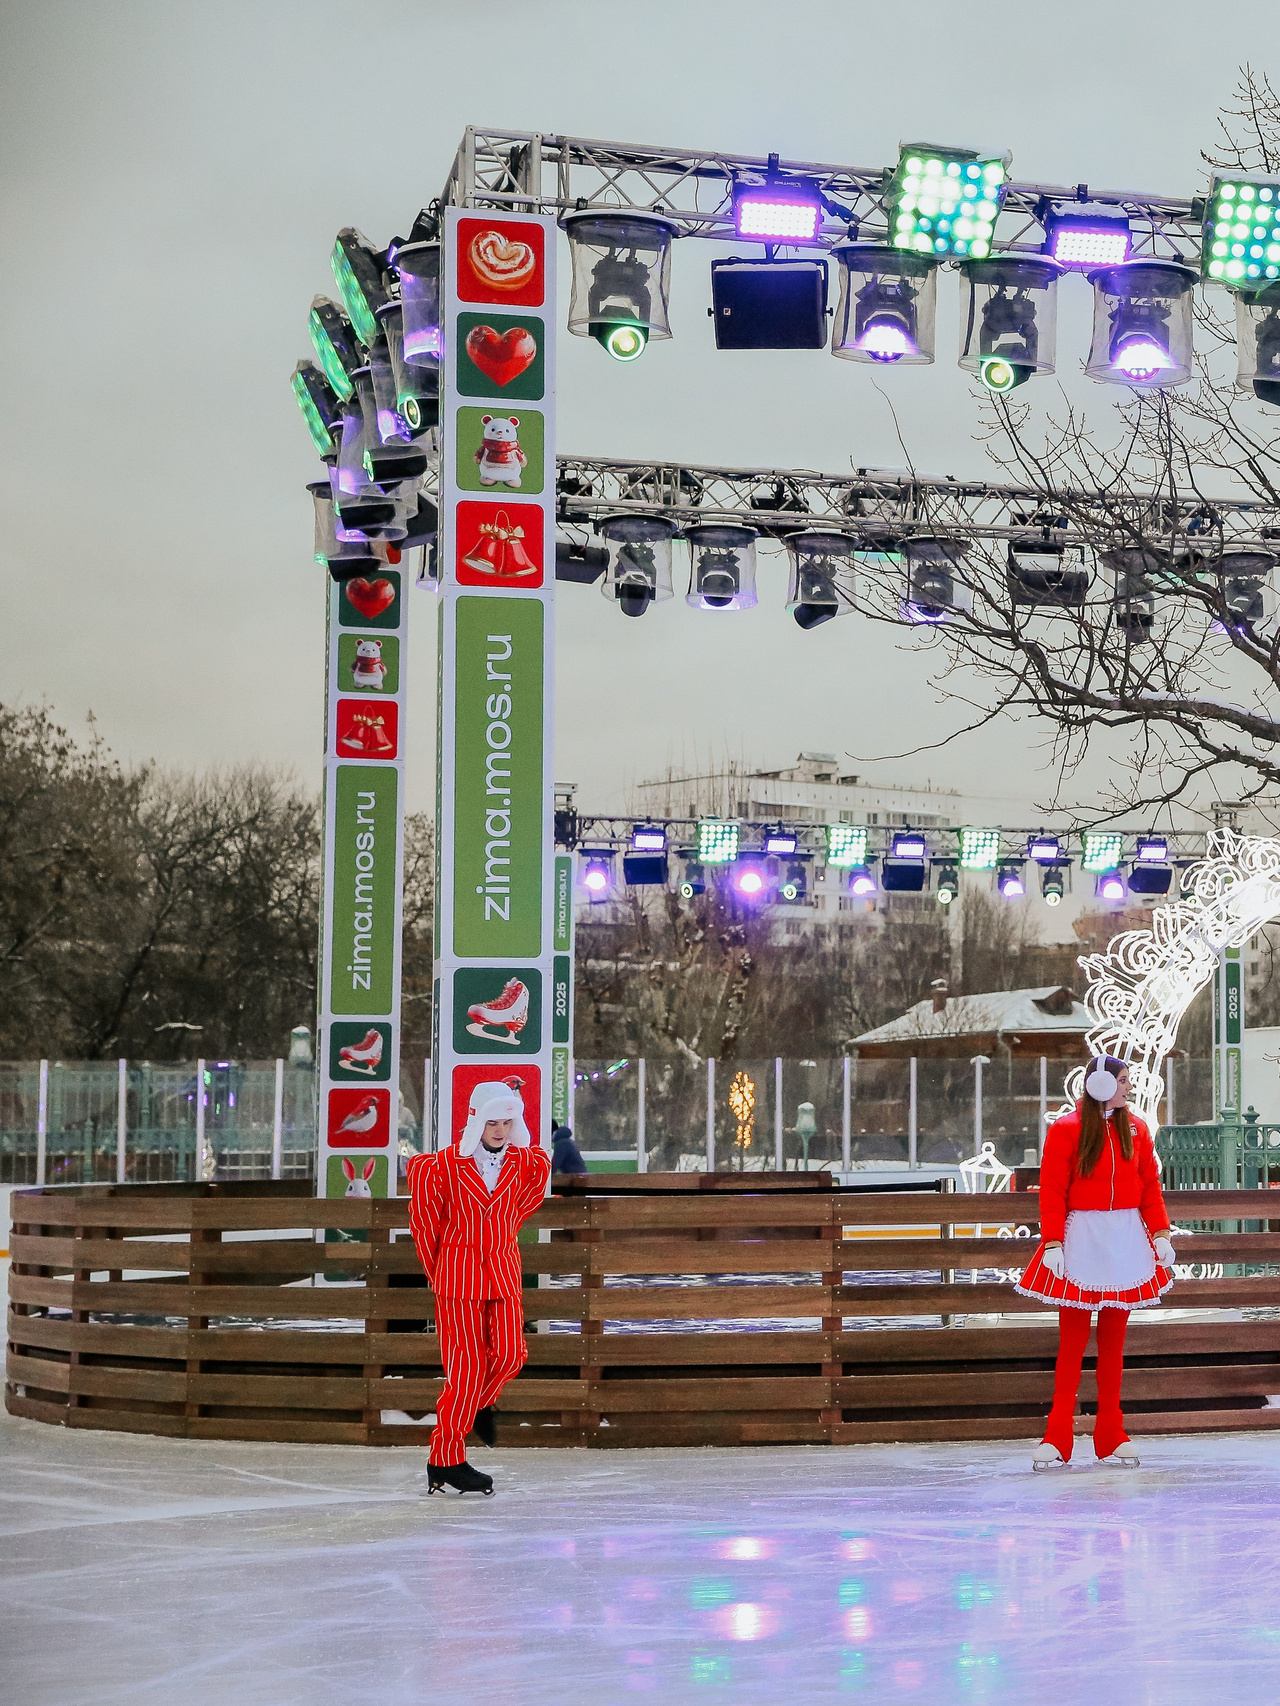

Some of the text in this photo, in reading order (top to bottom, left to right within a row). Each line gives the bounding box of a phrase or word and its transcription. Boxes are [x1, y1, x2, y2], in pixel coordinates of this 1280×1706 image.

[475, 634, 513, 922] zima.mos.ru
[348, 791, 378, 990] zima.mos.ru
[557, 868, 567, 938] zima.mos.ru
[556, 982, 567, 1016] 2025
[1228, 987, 1238, 1019] 2025
[555, 1099, 564, 1120] НА
